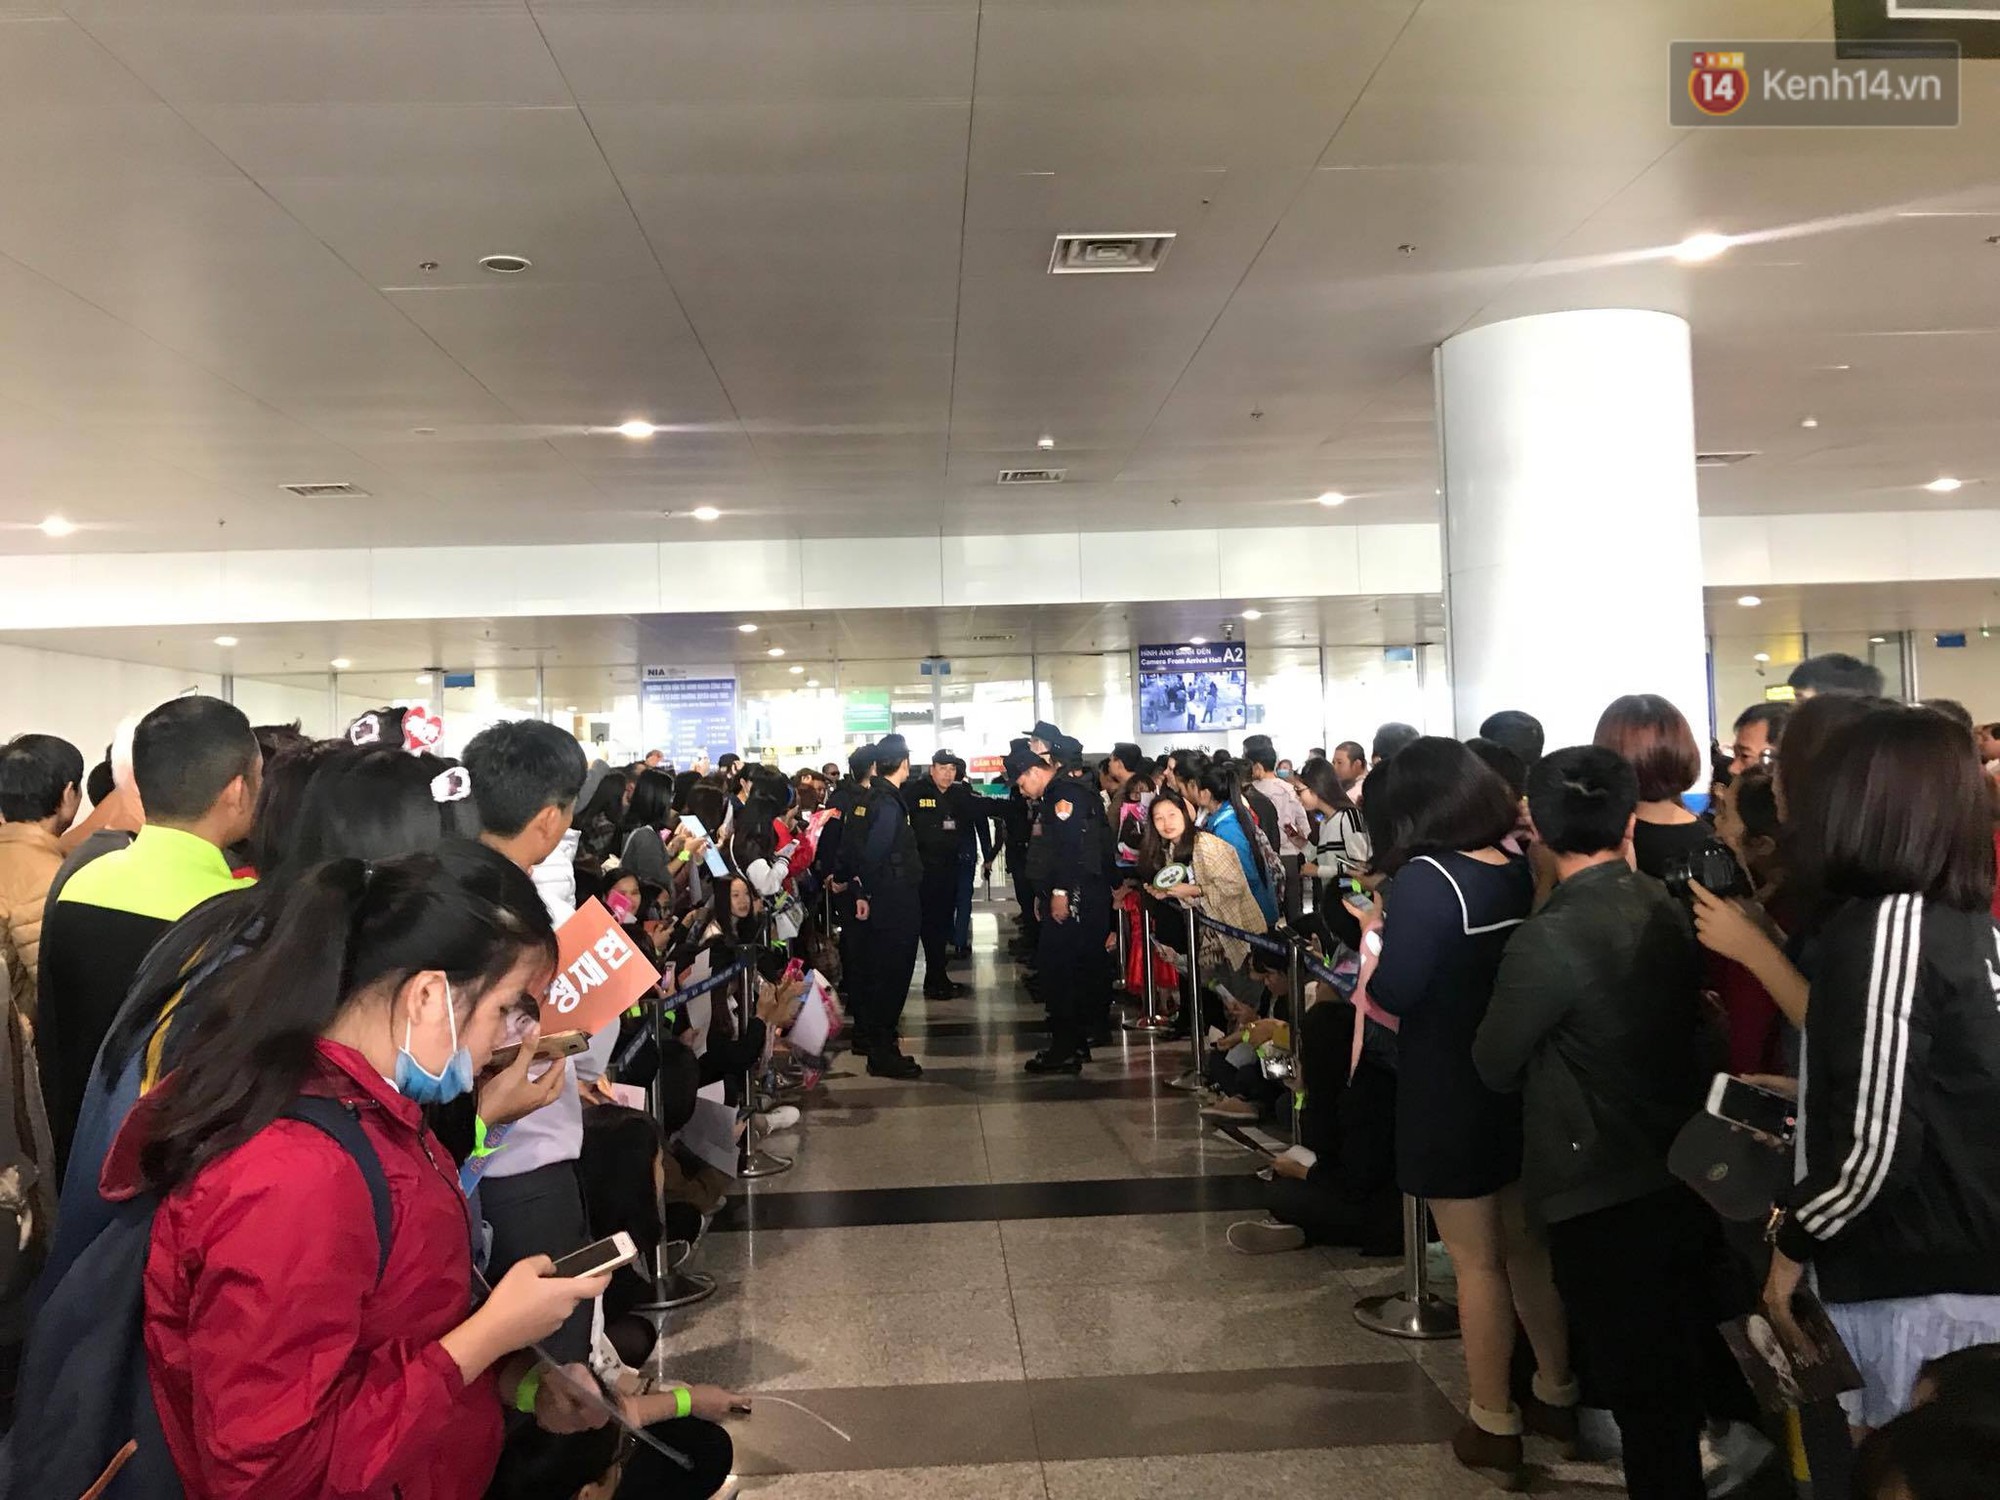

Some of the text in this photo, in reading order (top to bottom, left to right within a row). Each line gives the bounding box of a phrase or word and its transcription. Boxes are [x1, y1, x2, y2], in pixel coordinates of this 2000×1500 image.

[1223, 647, 1244, 663] A2
[1140, 658, 1166, 666] Camera
[1167, 657, 1185, 665] From
[647, 668, 665, 676] NIA
[919, 798, 937, 808] SBI
[548, 927, 634, 1013] 정재현
